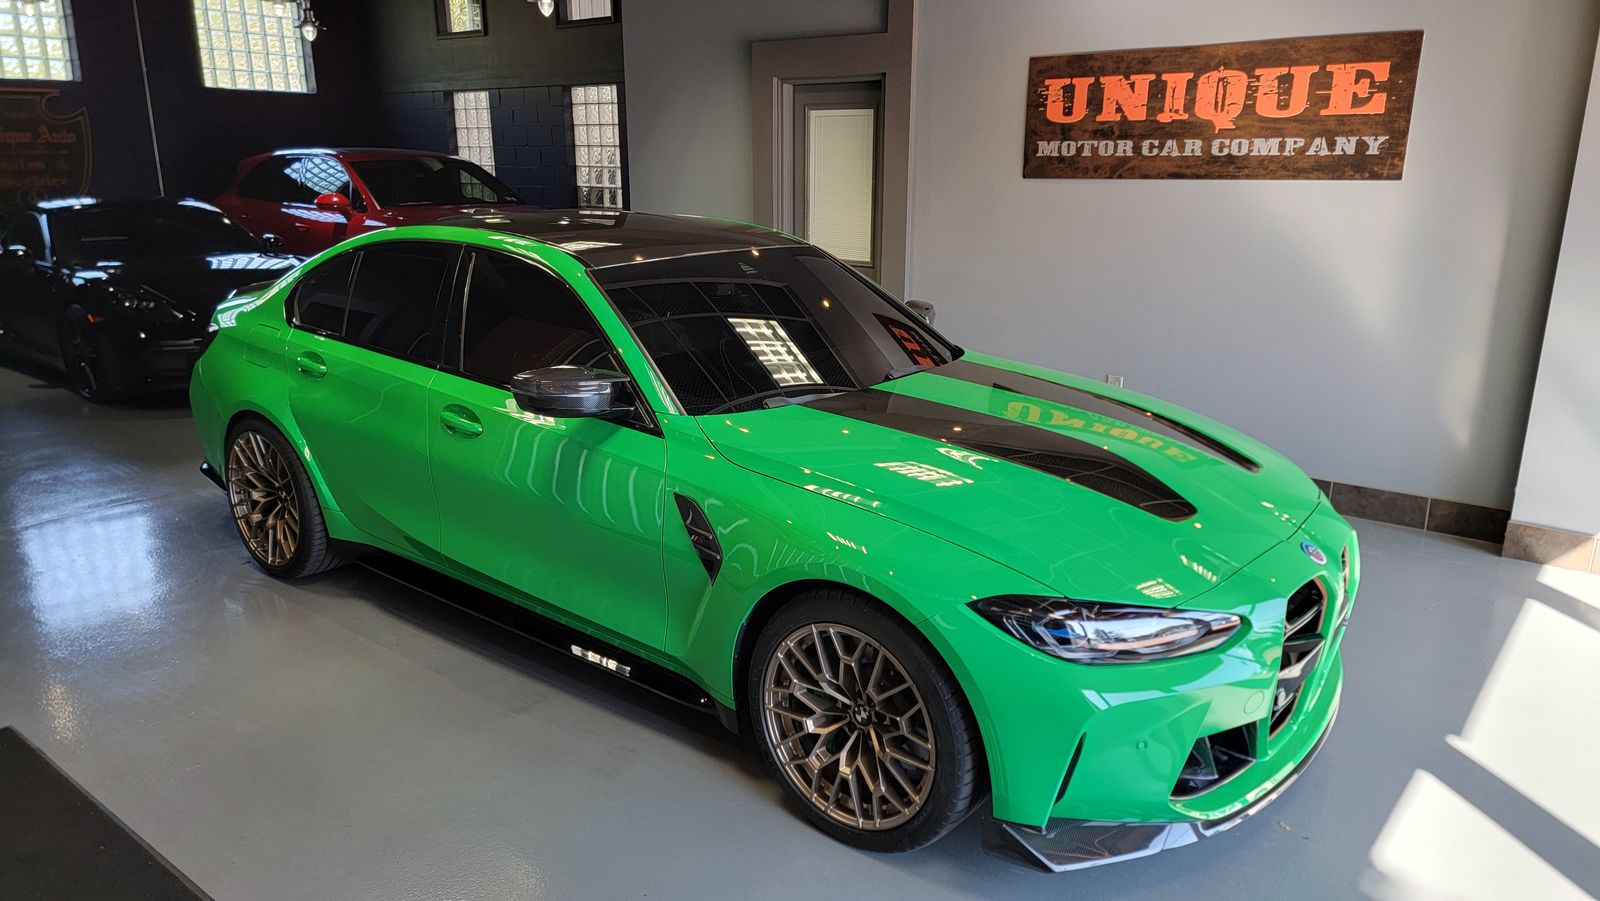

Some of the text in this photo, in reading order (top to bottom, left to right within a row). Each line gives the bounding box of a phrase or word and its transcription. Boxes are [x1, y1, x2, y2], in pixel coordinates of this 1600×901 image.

[1039, 61, 1392, 134] UNIQUE
[1036, 136, 1390, 157] MOTOR CAR COMPANY
